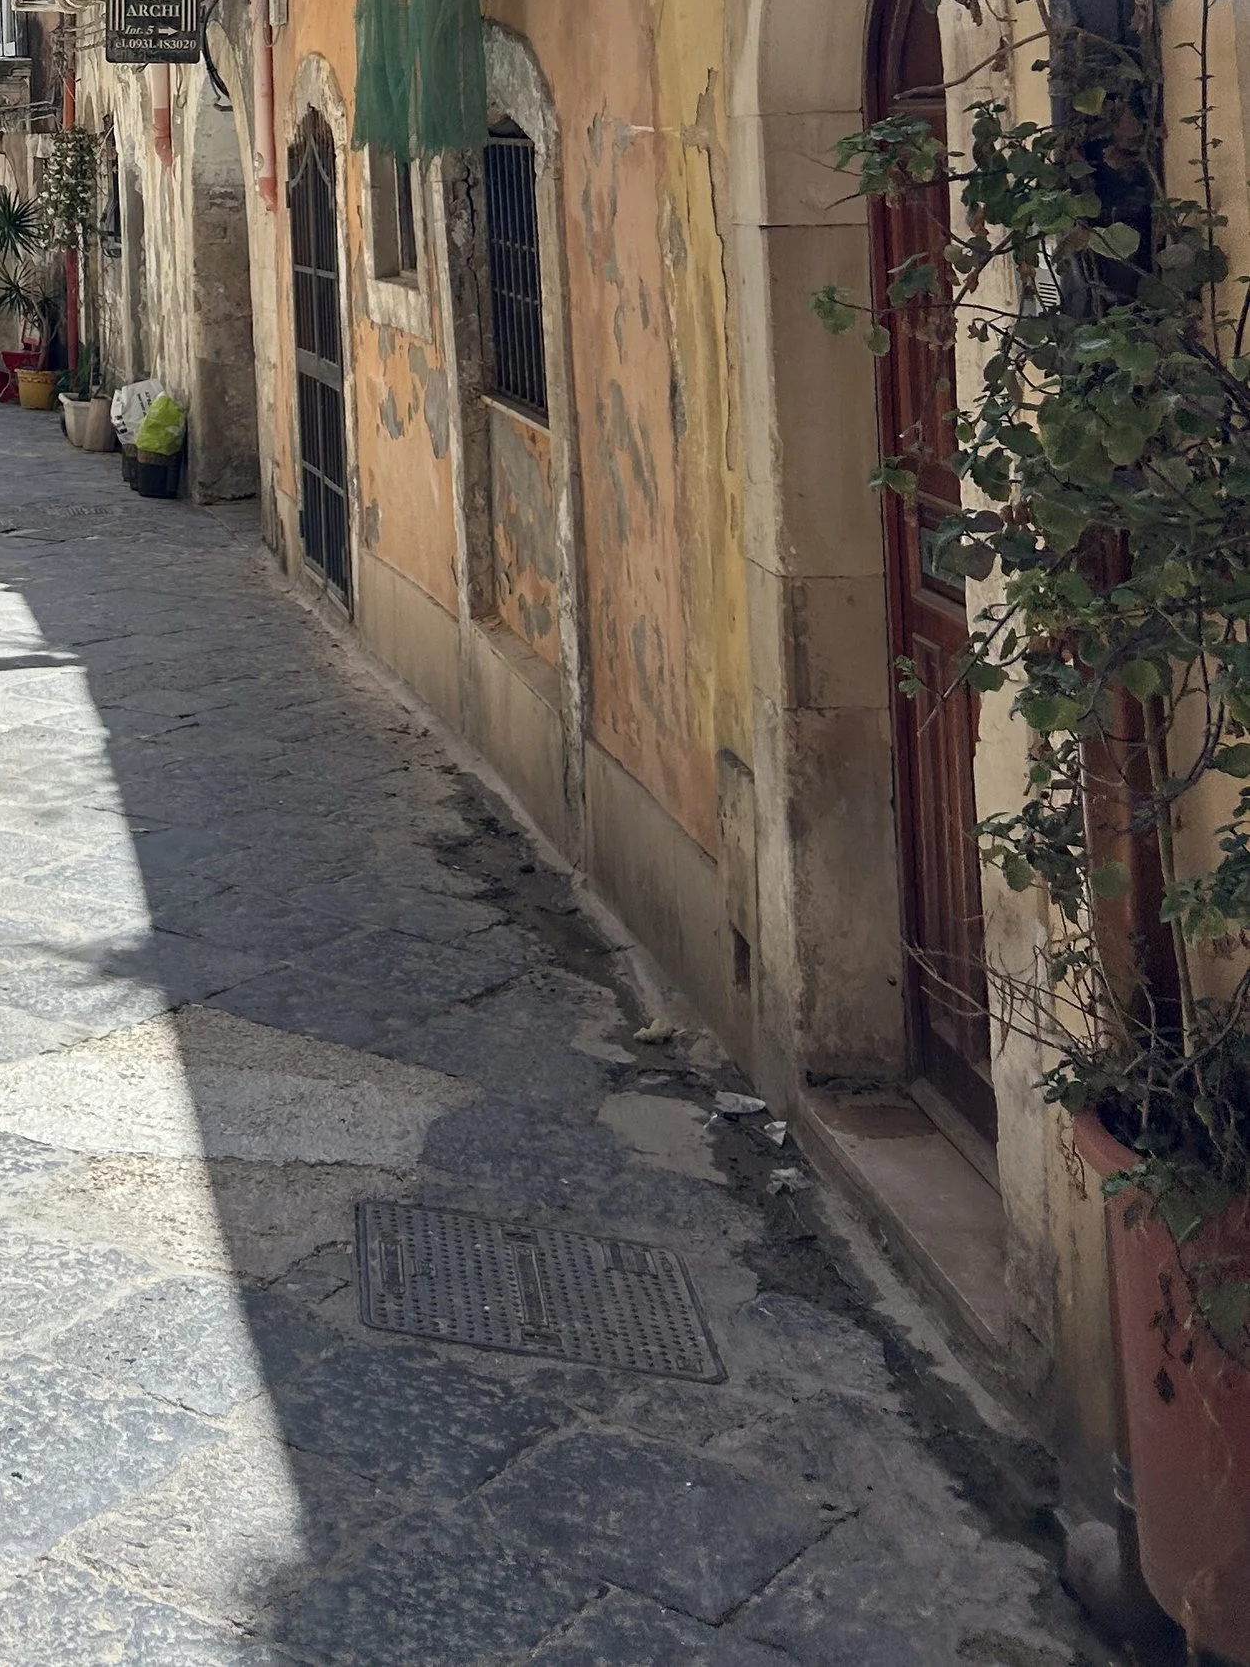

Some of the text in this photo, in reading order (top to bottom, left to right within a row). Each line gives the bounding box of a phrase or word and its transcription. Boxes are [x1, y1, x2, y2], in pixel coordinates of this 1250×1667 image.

[126, 4, 180, 17] ARCHI
[125, 25, 154, 35] Int. 5
